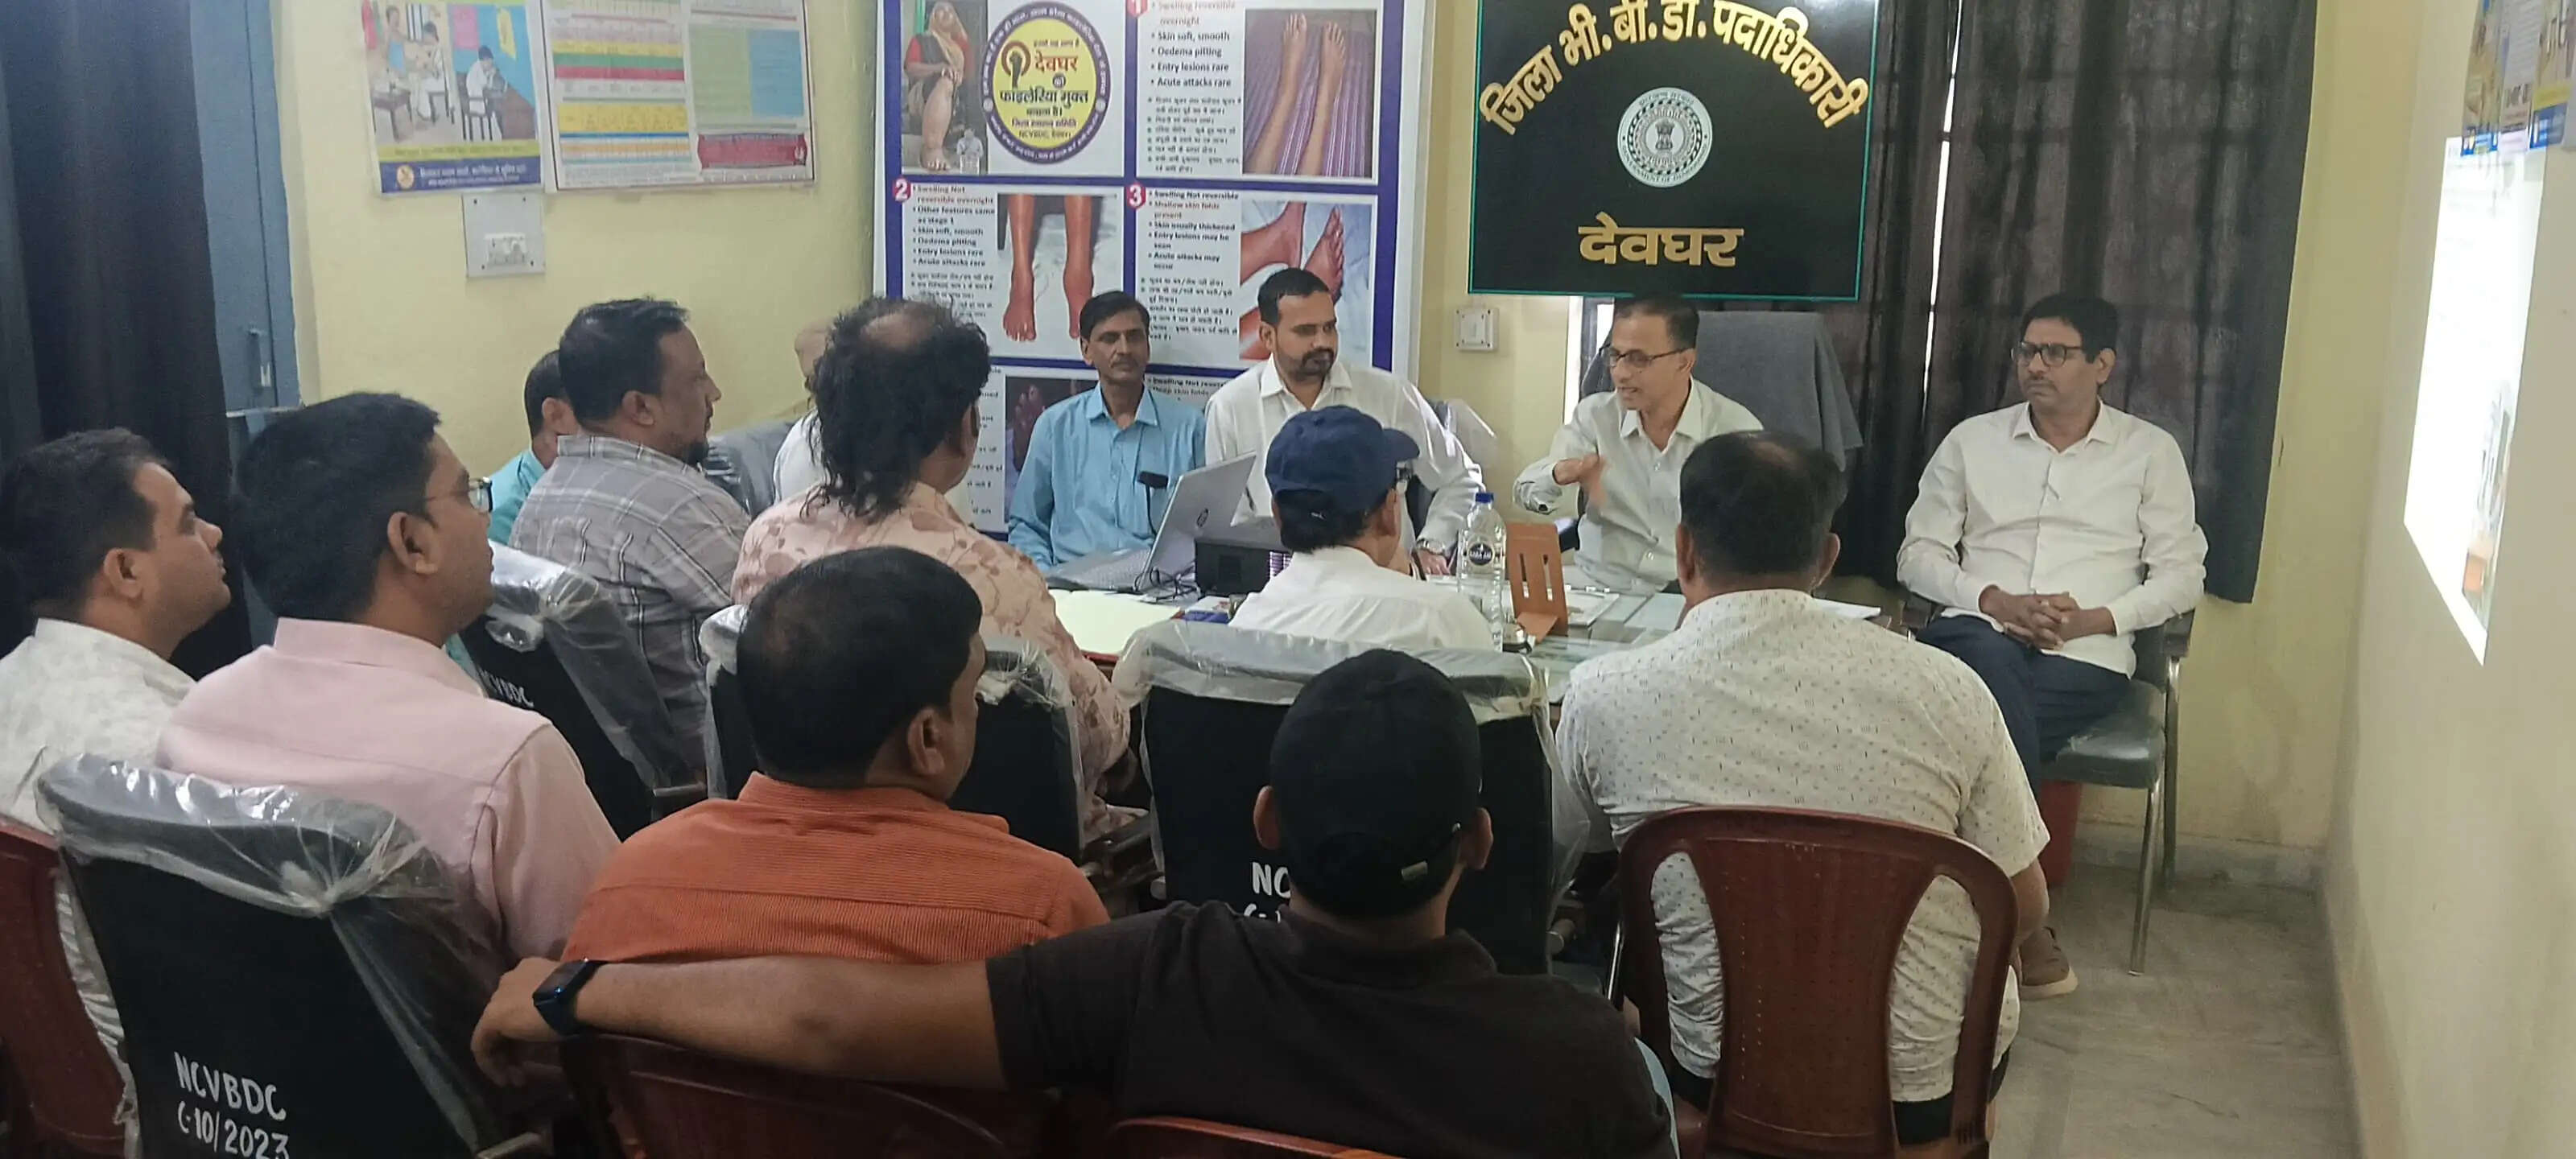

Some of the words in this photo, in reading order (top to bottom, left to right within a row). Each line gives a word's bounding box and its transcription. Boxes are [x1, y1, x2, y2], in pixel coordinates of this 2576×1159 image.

[1158, 31, 1175, 40] Skin
[1198, 31, 1230, 41] smooth
[1158, 46, 1193, 56] Oedema
[1195, 47, 1223, 58] pitting
[1034, 50, 1079, 73] देवघर
[1158, 62, 1179, 73] Entry
[1181, 62, 1210, 71] lesions
[1212, 64, 1229, 72] rare
[1158, 77, 1181, 86] Acute
[1183, 77, 1212, 86] attacks
[1214, 79, 1232, 87] rare
[1480, 45, 1563, 135] जिला
[895, 179, 908, 201] 2
[1154, 190, 1185, 200] Swelling
[1187, 191, 1200, 199] Not
[1129, 184, 1141, 207] 3
[941, 206, 973, 214] features
[954, 228, 984, 236] smooth
[1171, 222, 1198, 232] usually
[1199, 222, 1236, 231] thickened
[1154, 231, 1174, 241] Entry
[1174, 232, 1201, 241] lesions
[1578, 212, 1744, 267] देवघर
[918, 237, 951, 245] Oedema
[952, 237, 977, 246] pitting
[918, 247, 938, 257] Entry
[939, 248, 966, 256] lesions
[968, 249, 984, 257] rare
[1154, 251, 1175, 260] Acute
[1177, 251, 1203, 262] attacks
[1203, 254, 1220, 262] may
[918, 257, 940, 266] Acute
[941, 258, 968, 267] attacks
[969, 258, 986, 267] rare
[1152, 376, 1183, 386] Swelling
[174, 1050, 287, 1121] NCVBDC
